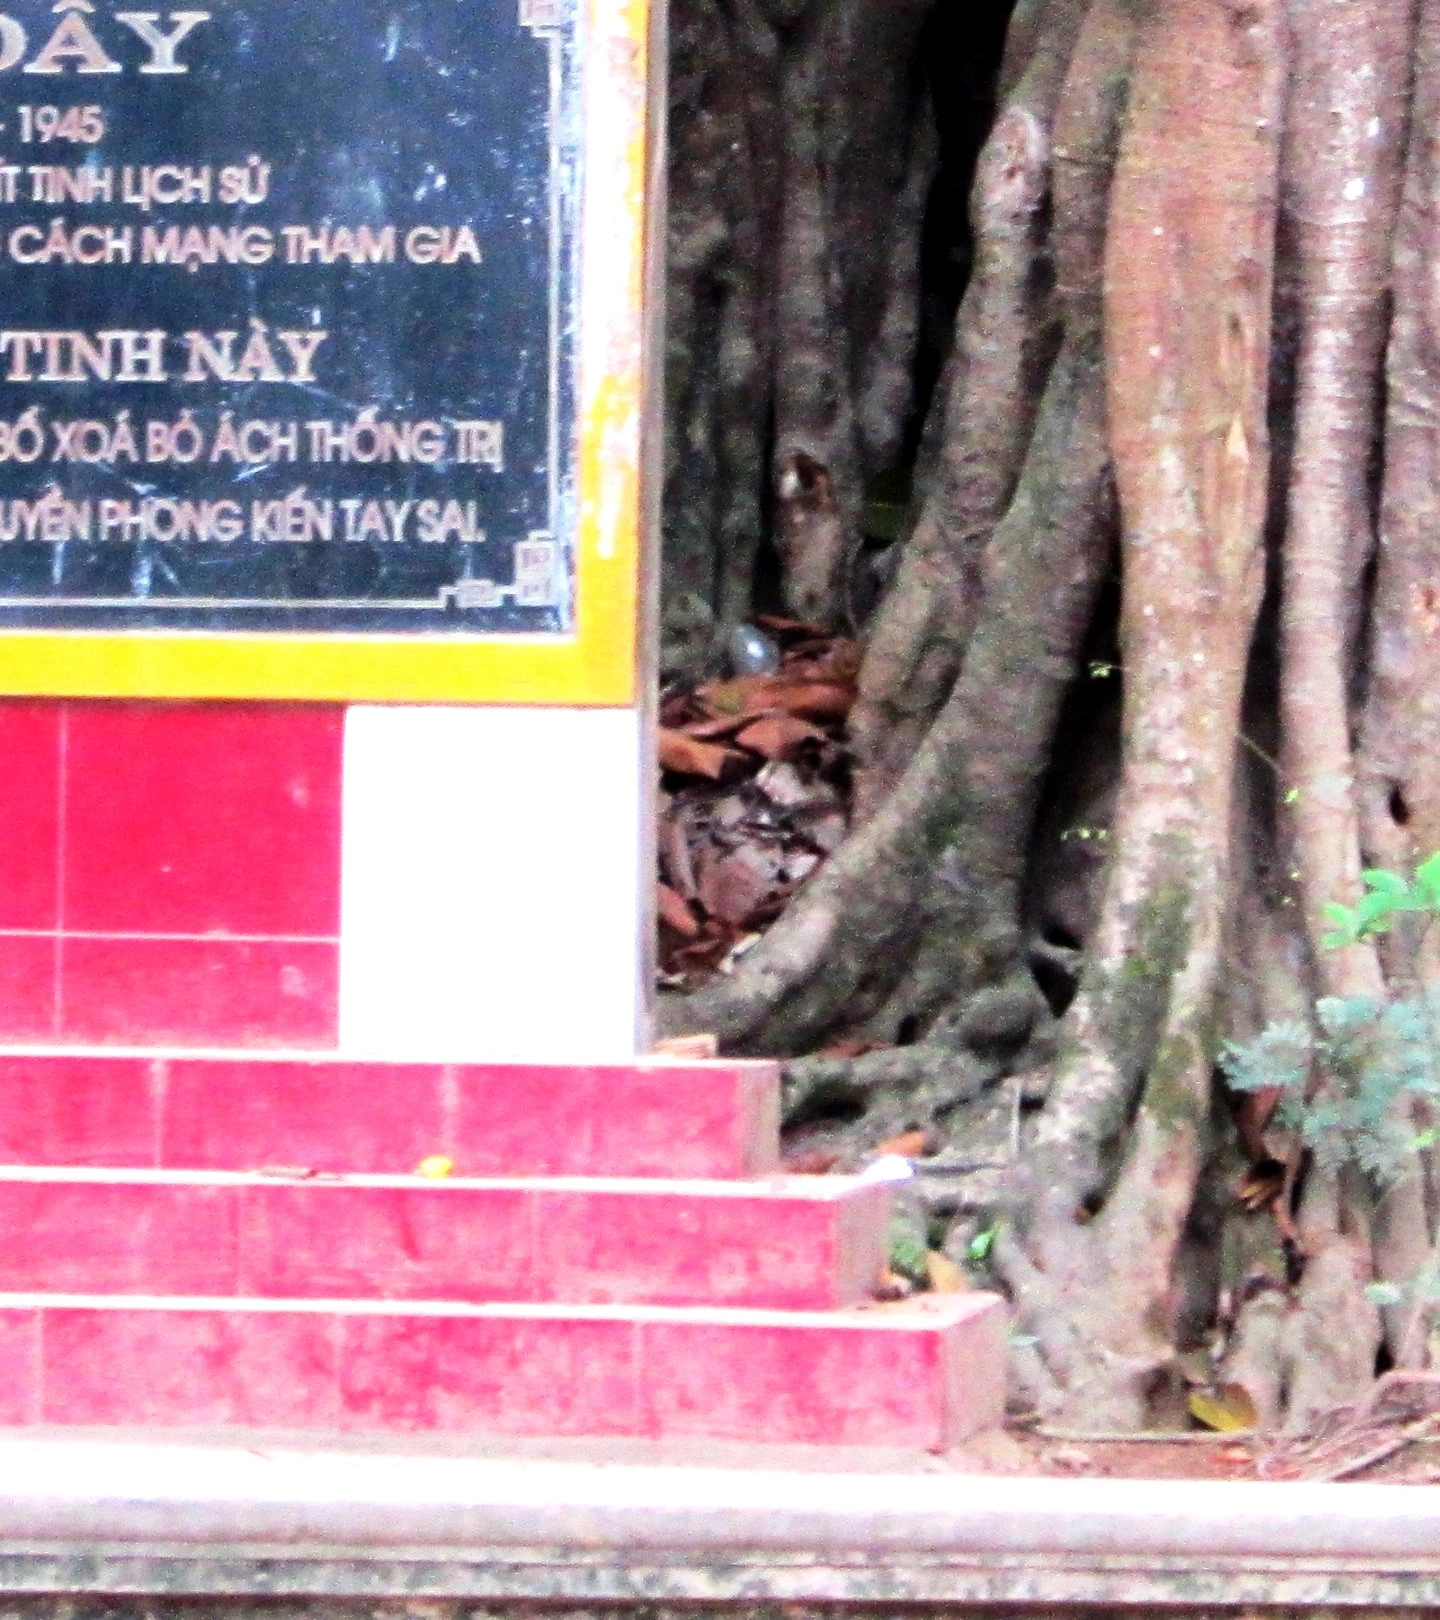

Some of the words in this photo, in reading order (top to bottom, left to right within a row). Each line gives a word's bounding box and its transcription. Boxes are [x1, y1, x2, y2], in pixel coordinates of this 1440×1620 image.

[17, 106, 106, 143] 1945
[27, 165, 113, 204] TINH
[122, 165, 211, 211] LỊCH
[219, 155, 271, 205] SỬ
[9, 215, 131, 264] CÁCH
[140, 226, 274, 272] MẠNG
[281, 226, 394, 263] THAM
[404, 226, 481, 264] GIA
[184, 318, 327, 381] NÀY
[51, 409, 139, 462] XOÁ
[210, 409, 297, 462] ÁCH
[303, 405, 445, 462] THỐNG
[454, 420, 505, 473] TRỊ
[98, 499, 245, 542] PHONG
[251, 486, 332, 542] KIẾN
[340, 499, 410, 542] TAY
